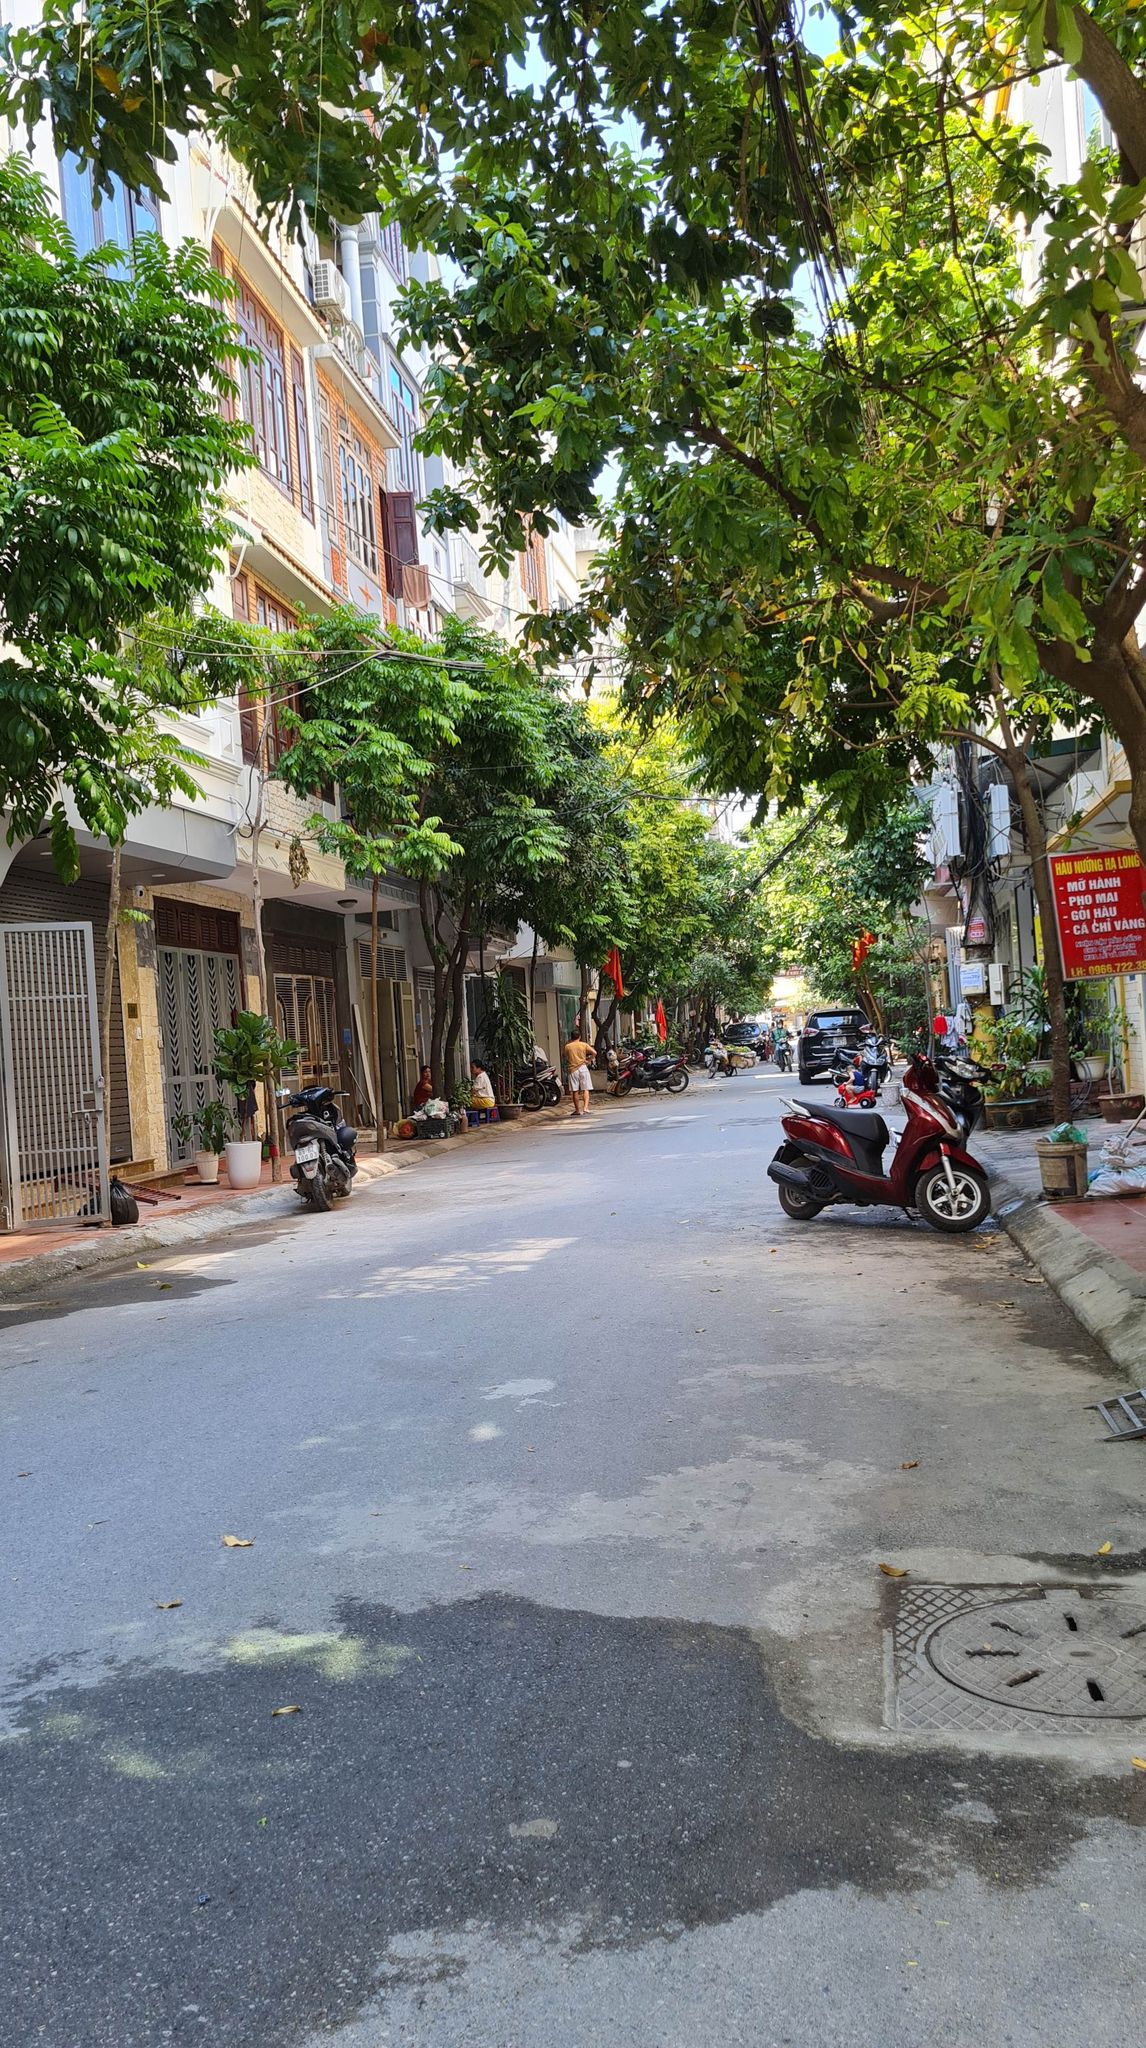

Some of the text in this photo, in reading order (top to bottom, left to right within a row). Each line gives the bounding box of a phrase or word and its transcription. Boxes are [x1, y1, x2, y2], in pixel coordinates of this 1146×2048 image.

[1055, 854, 1141, 876] HÀU NƯỚNG HẠ LONG
[1066, 876, 1121, 893] MỠ HÀNH
[1068, 891, 1119, 907] PHO MAI
[1093, 905, 1117, 919] HÀU
[1072, 921, 1089, 935] CÁ
[1113, 917, 1145, 931] VÀNG
